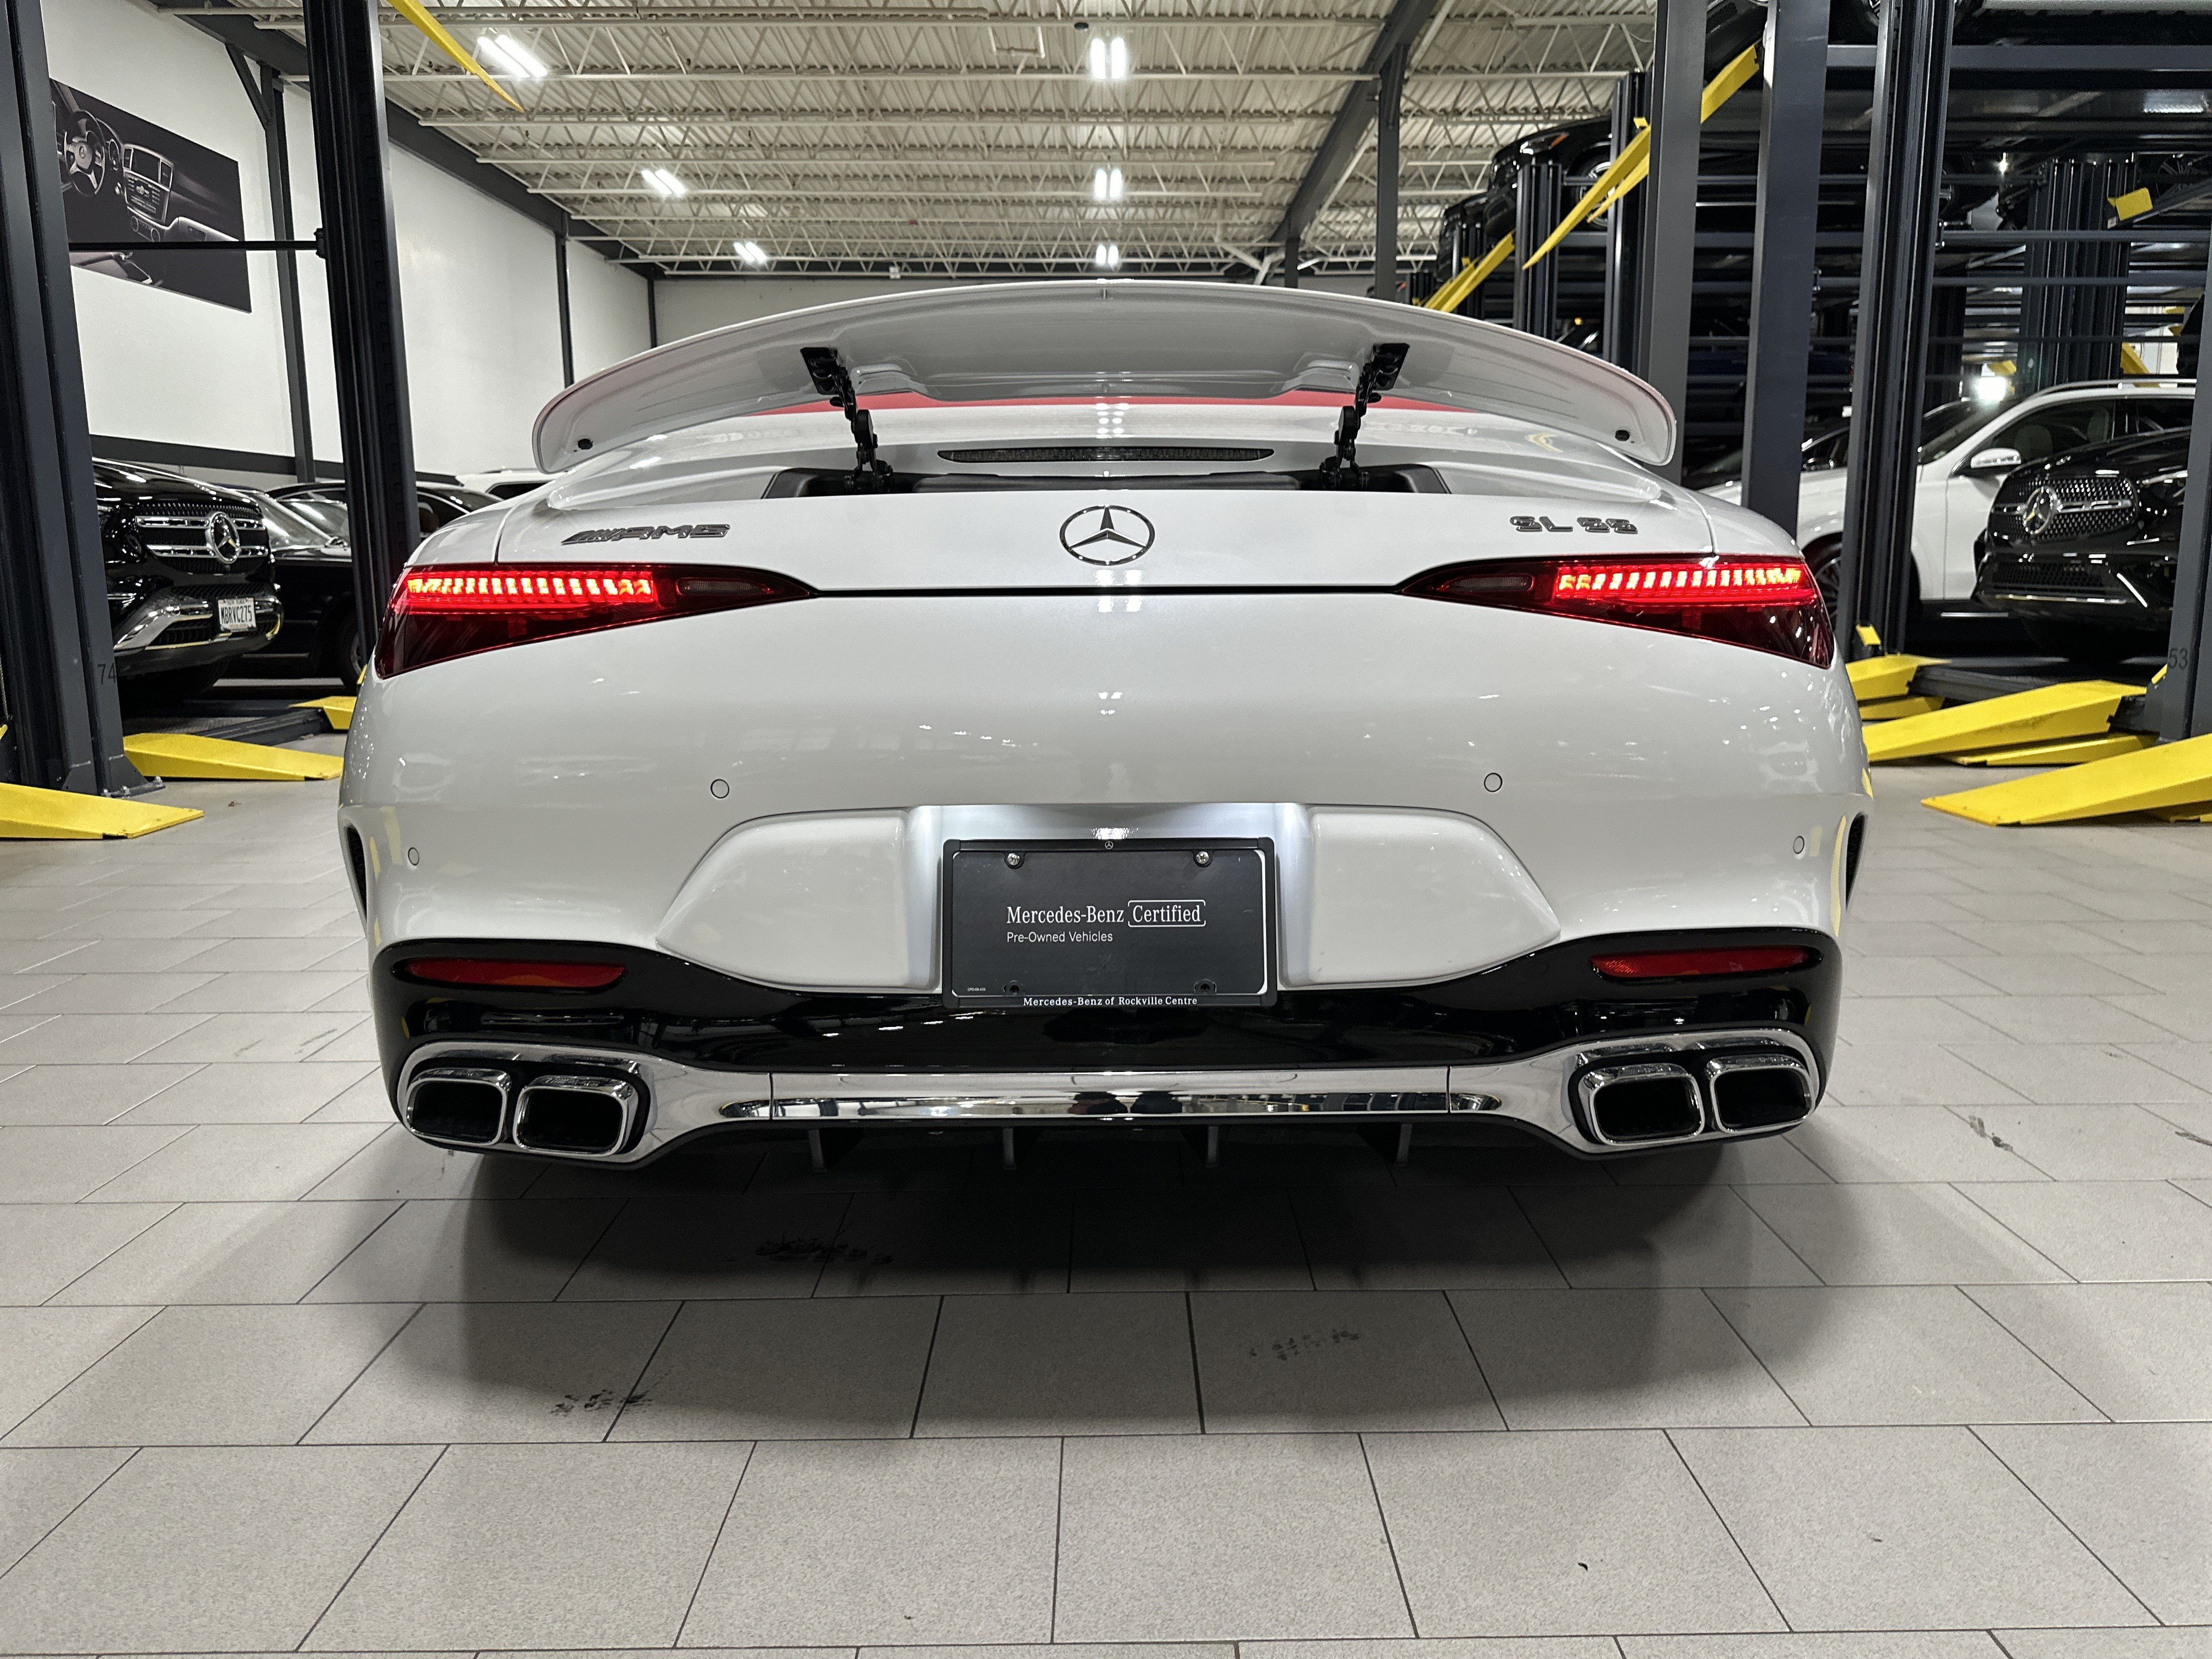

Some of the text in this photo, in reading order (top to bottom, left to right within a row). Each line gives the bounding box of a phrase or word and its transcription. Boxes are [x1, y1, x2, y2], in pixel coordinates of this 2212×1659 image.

[1509, 516, 1573, 532] SL
[561, 523, 731, 546] AMG
[2168, 647, 2188, 669] 53
[97, 662, 117, 685] 74
[1006, 905, 1201, 924] Mercedes-Benz Certified
[1006, 930, 1113, 943] Pre-Owned Vehicles
[1023, 996, 1198, 1006] Mercedes-Benz of Rockville Centre
